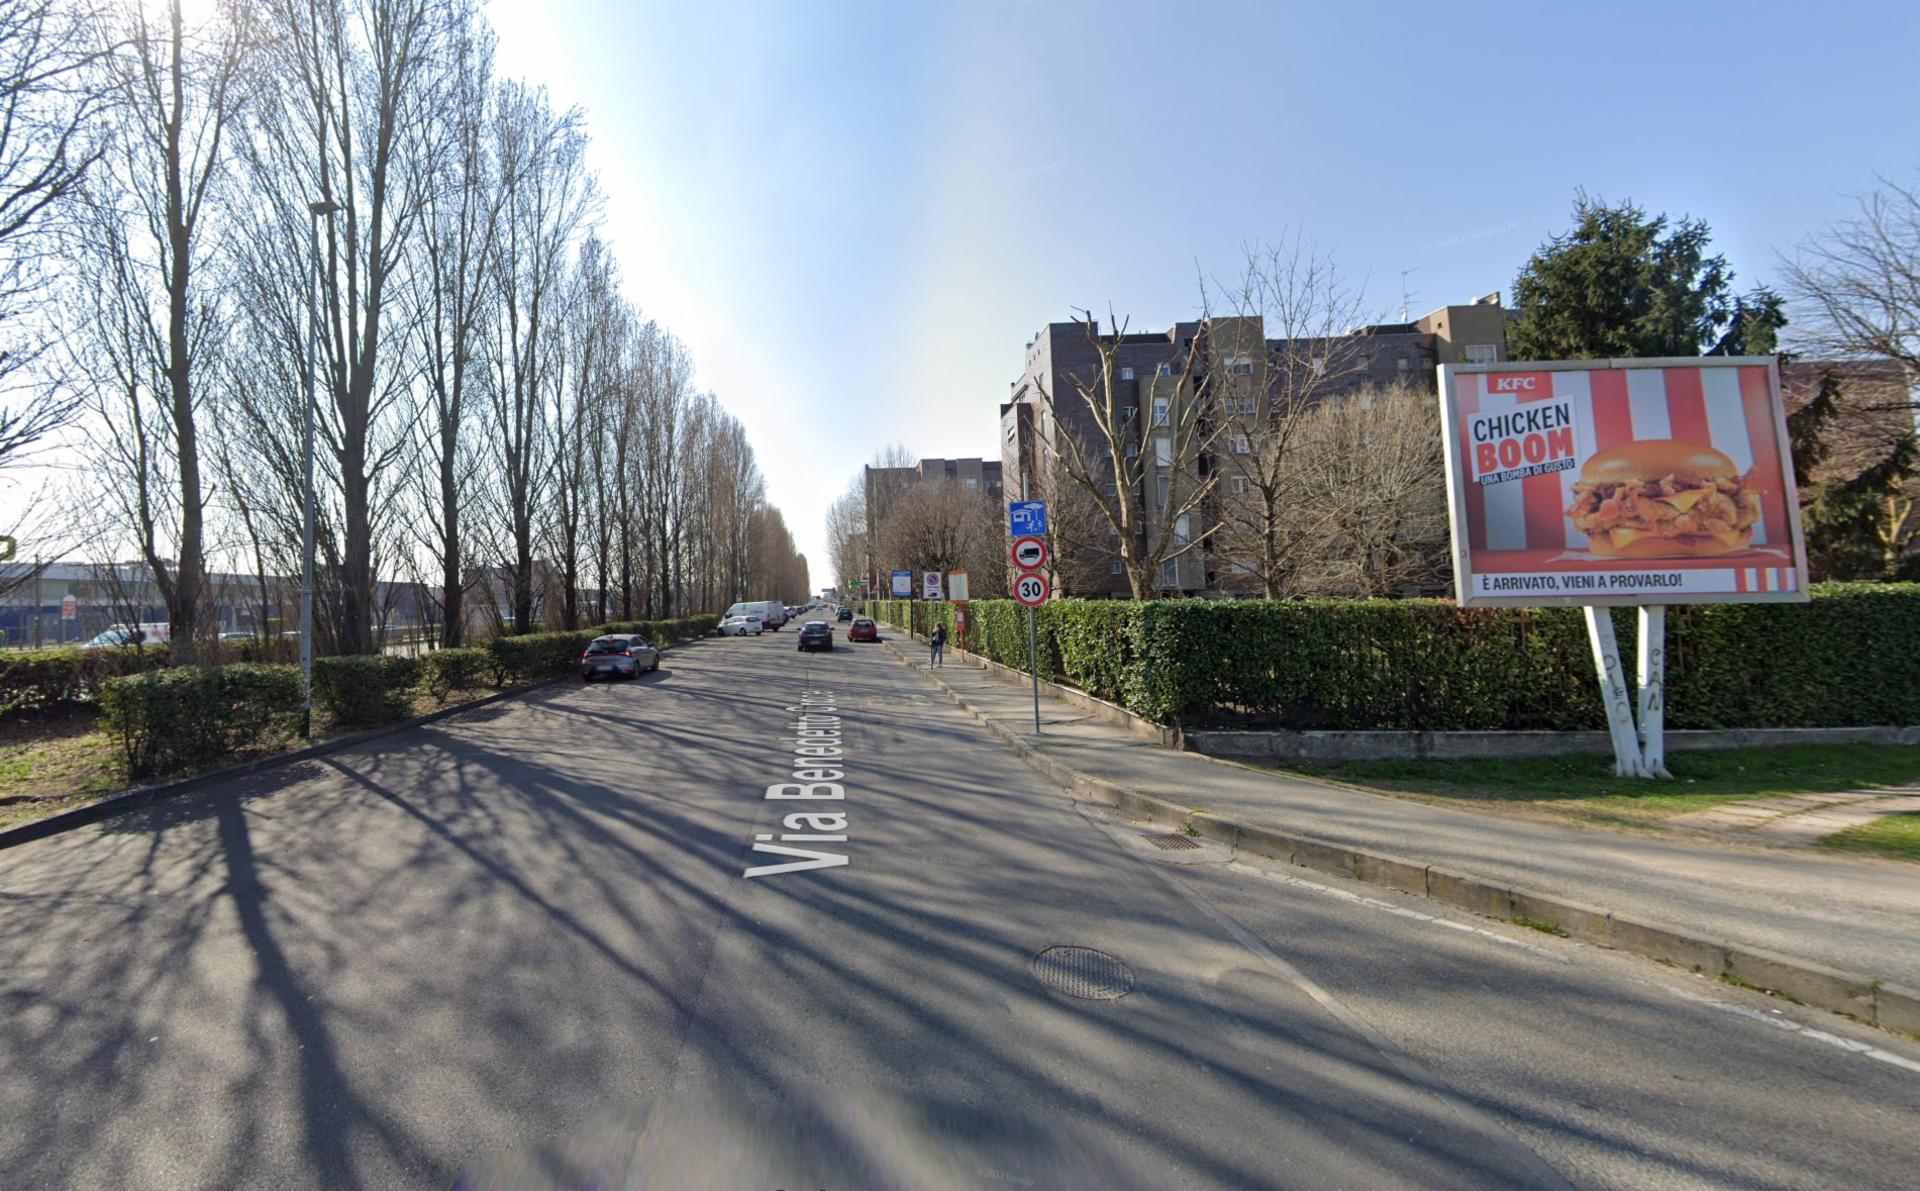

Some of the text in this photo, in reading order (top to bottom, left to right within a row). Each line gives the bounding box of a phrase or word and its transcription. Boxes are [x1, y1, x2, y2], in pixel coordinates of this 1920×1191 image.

[1496, 377, 1536, 391] KFC
[1474, 403, 1570, 442] CHICKEN
[1477, 427, 1574, 474] BOOM
[1481, 459, 1574, 486] UNA BOMBA DI GUSTO
[1021, 581, 1042, 598] 30
[1483, 573, 1683, 591] È ARRIVATO, VIENI A PROVARLO!
